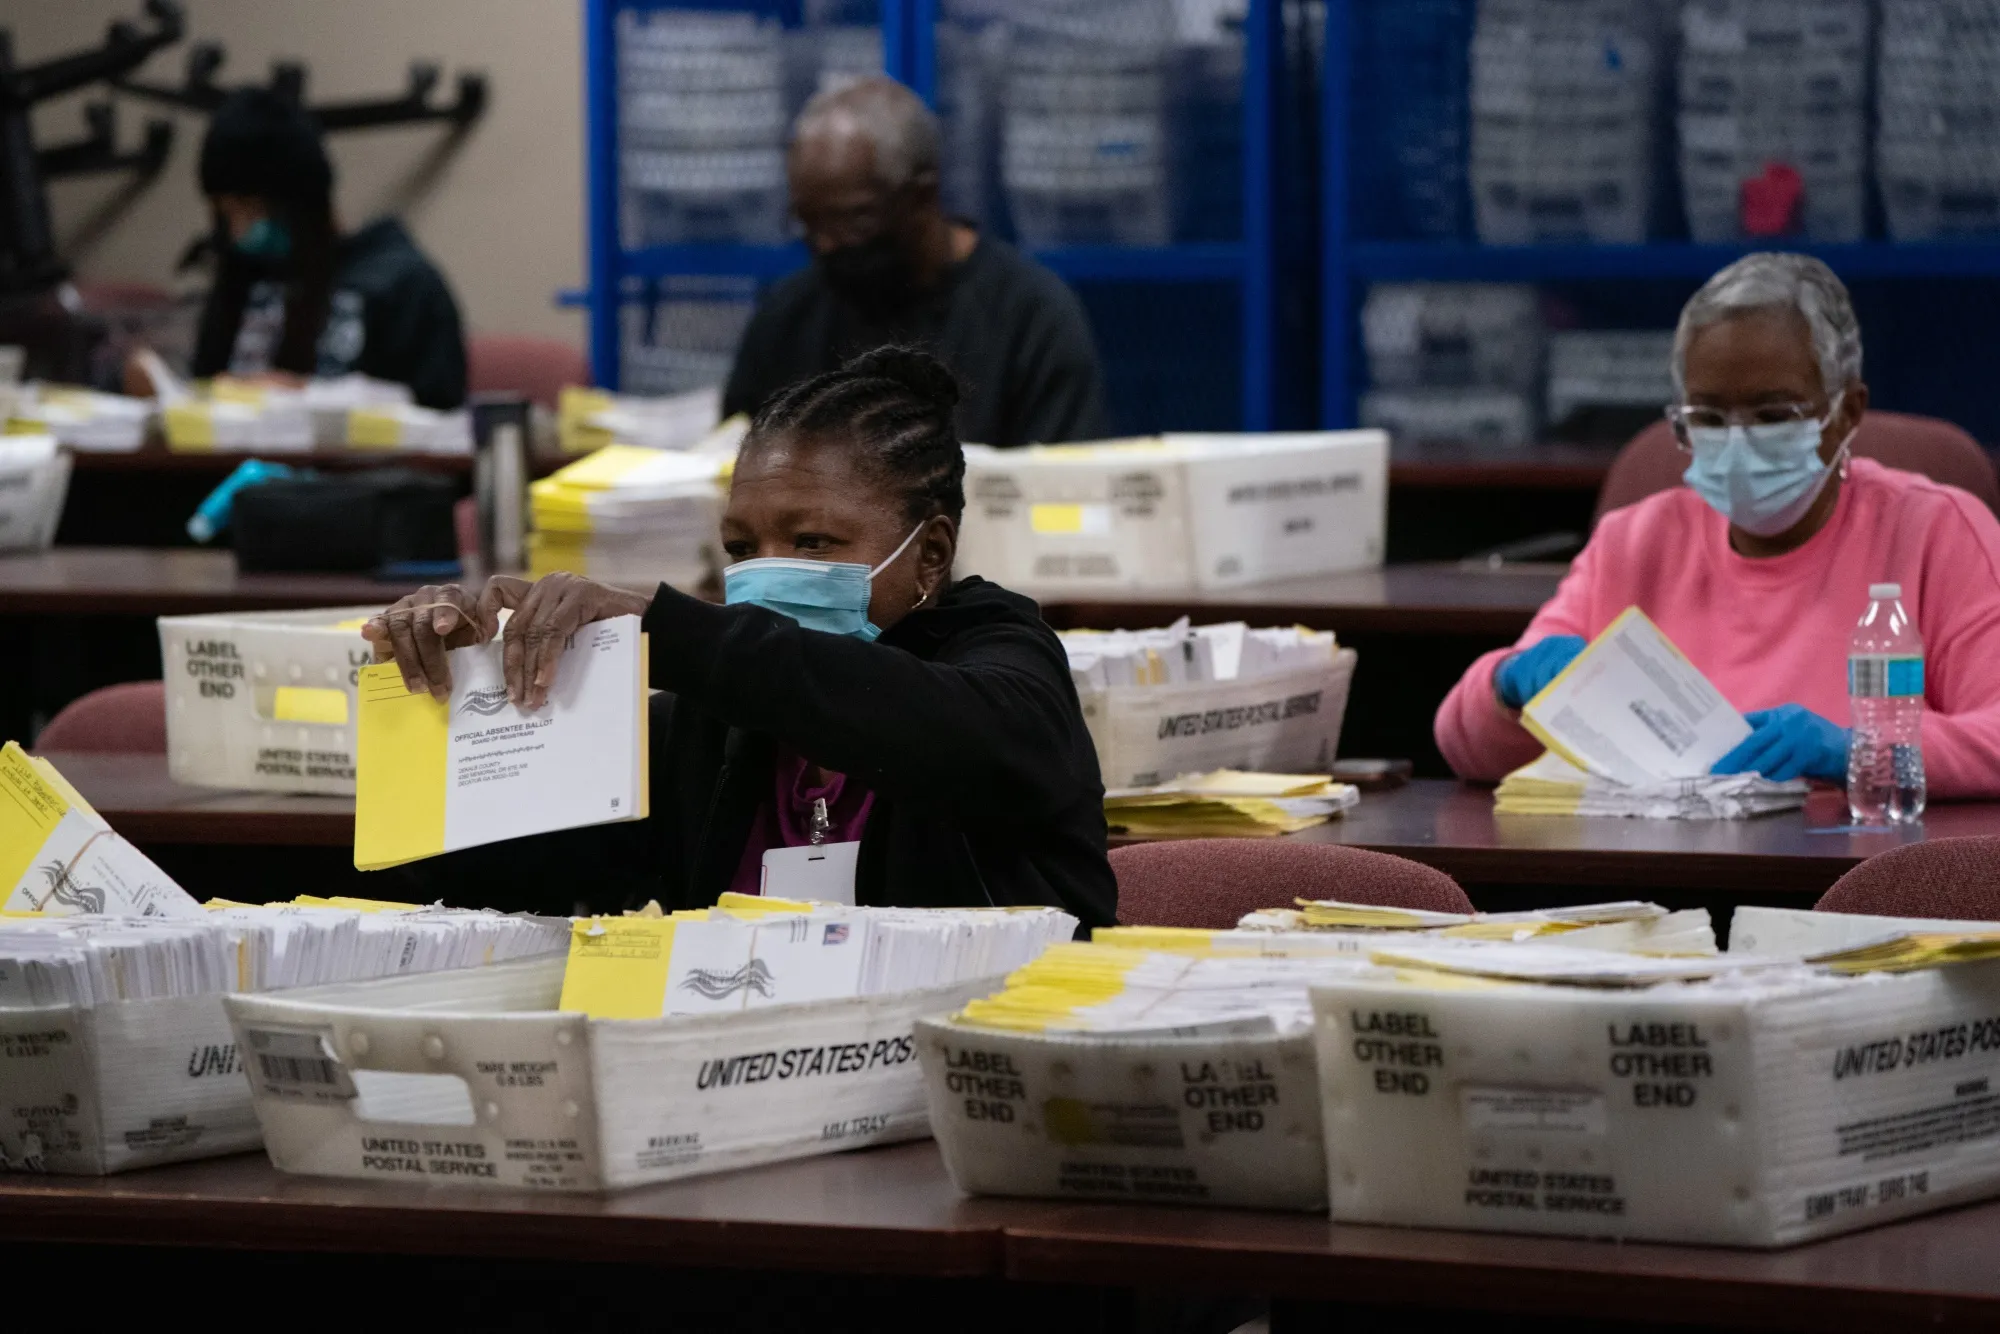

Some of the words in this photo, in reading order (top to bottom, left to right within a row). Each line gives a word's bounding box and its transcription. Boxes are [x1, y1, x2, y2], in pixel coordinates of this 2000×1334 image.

[186, 639, 241, 659] LABEL
[187, 658, 245, 680] OTHER
[199, 680, 235, 698] END
[455, 731, 485, 743] OFFICIAL
[485, 724, 524, 736] ABSENTEE
[525, 719, 554, 730] BALLOT
[1352, 1010, 1439, 1039] LABEL
[1608, 1022, 1708, 1049] LABEL
[944, 1046, 1022, 1077] LABEL
[1353, 1038, 1444, 1068] OTHER
[1832, 1037, 1903, 1080] UNITED
[1903, 1022, 1967, 1068] STATES
[697, 1051, 777, 1090] UNITED
[777, 1043, 869, 1079] STATES
[1610, 1052, 1714, 1078] OTHER
[946, 1071, 1026, 1101] OTHER
[1374, 1068, 1430, 1096] END
[1632, 1082, 1697, 1109] END
[1184, 1083, 1280, 1109] OTHER
[964, 1099, 1015, 1124] END
[1206, 1110, 1265, 1133] END
[361, 1137, 420, 1156] UNITED
[423, 1140, 486, 1159] STATES
[362, 1156, 426, 1173] POSTAL
[429, 1159, 497, 1178] SERVICE
[1468, 1167, 1540, 1189] UNITED
[1543, 1171, 1615, 1194] STATES
[1465, 1190, 1538, 1212] POSTAL
[1543, 1193, 1626, 1217] SERVICE
